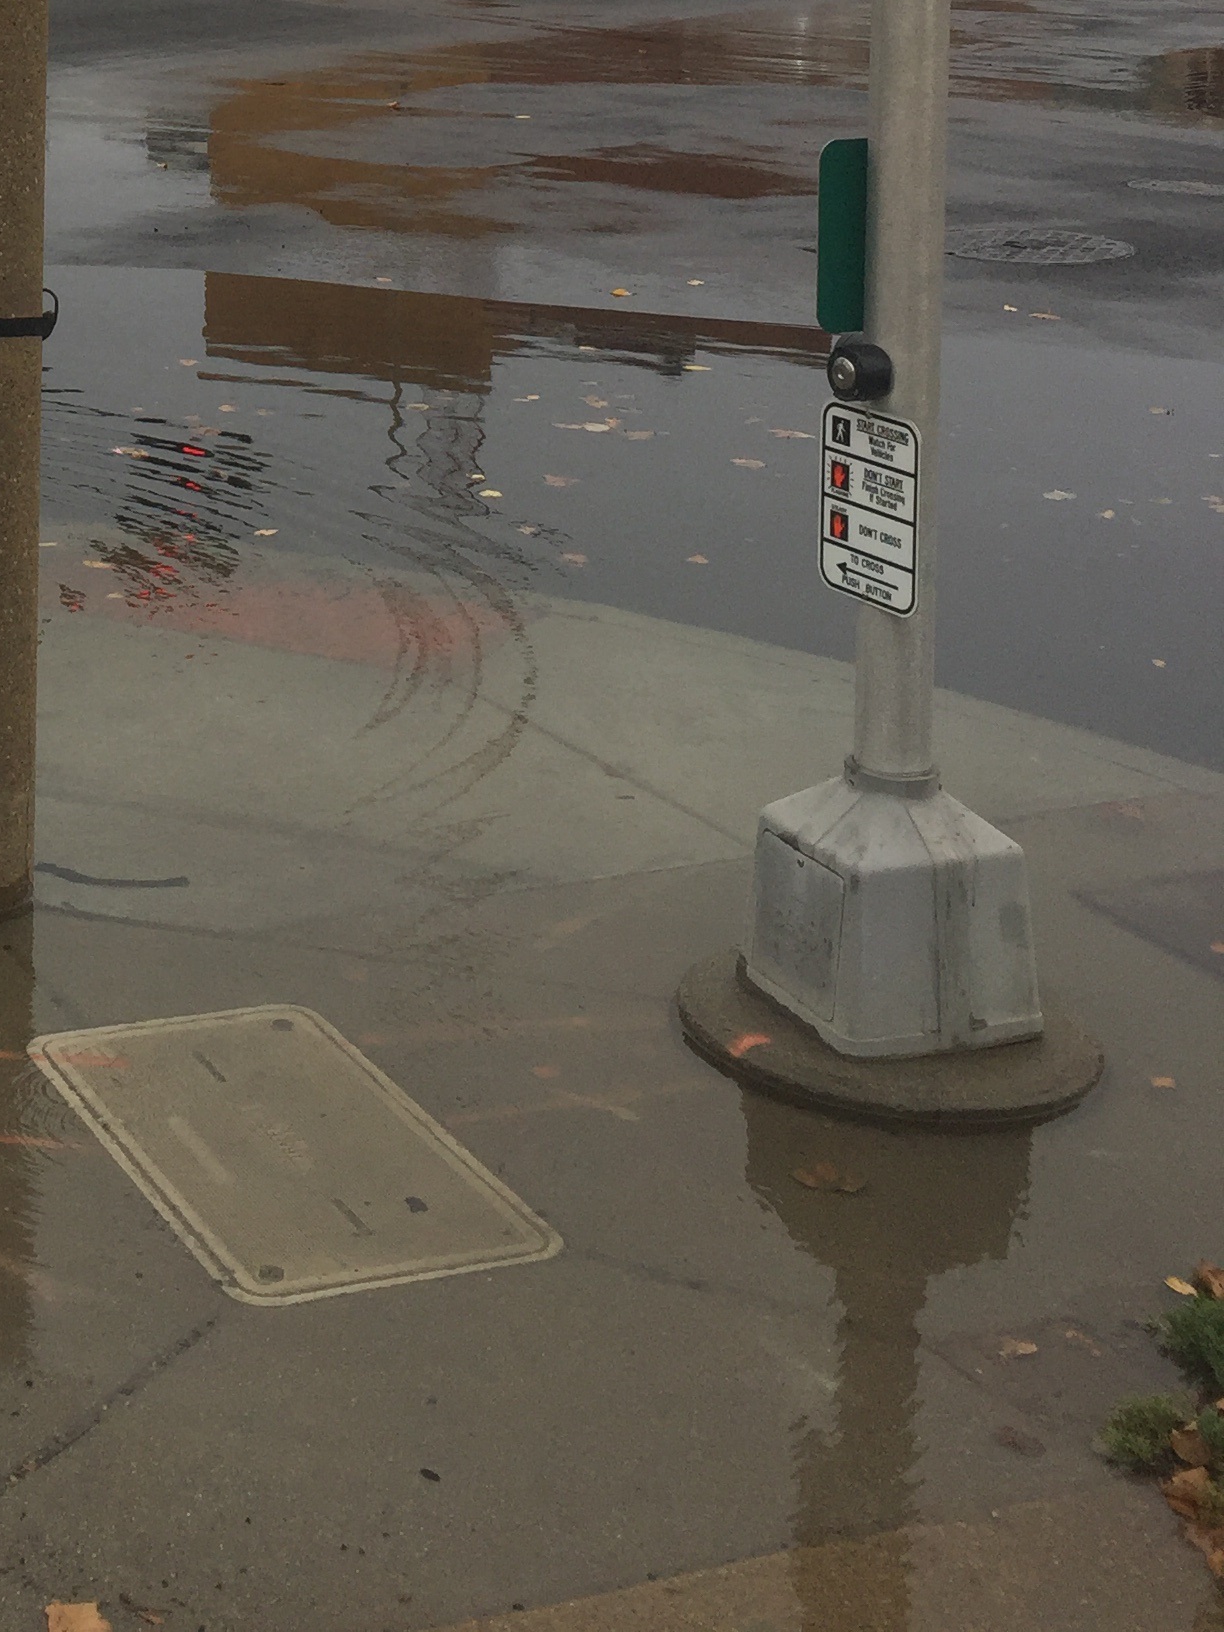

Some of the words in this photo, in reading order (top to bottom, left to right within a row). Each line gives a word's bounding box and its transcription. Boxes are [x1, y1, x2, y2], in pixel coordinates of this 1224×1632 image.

[856, 418, 874, 432] START
[877, 424, 909, 444] CROSSING
[864, 467, 882, 483] DON'T
[884, 474, 903, 489] START
[858, 524, 878, 540] DON'T
[879, 531, 902, 549] CROSS
[850, 553, 859, 566] TO
[861, 558, 884, 575] CROSS
[841, 573, 860, 589] PUSH
[865, 583, 892, 602] BUTTON
